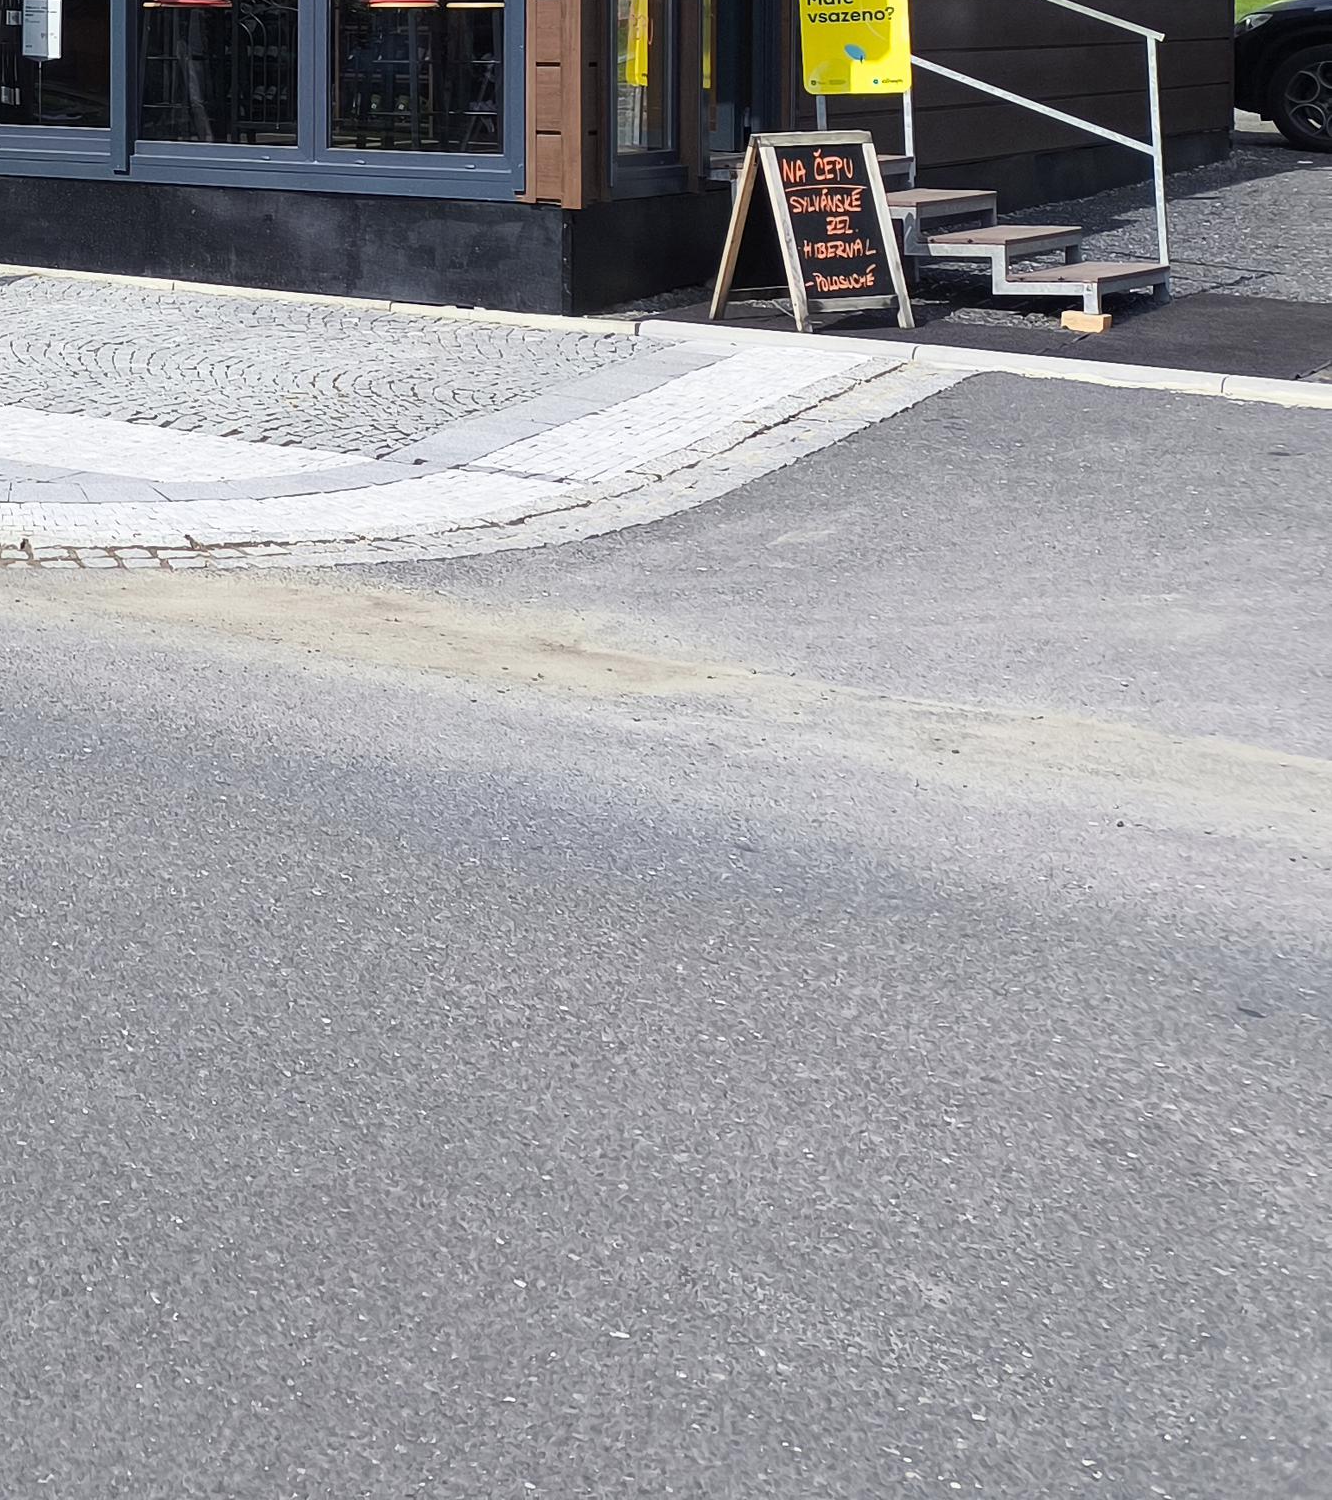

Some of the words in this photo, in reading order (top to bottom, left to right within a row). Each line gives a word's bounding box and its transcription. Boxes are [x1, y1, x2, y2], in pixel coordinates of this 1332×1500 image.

[807, 6, 895, 23] vsazeno?
[782, 158, 806, 183] NA
[813, 149, 854, 182] ČEPU
[789, 188, 863, 214] SYLVÁNSKÉ
[803, 239, 876, 260] HIBERNAL
